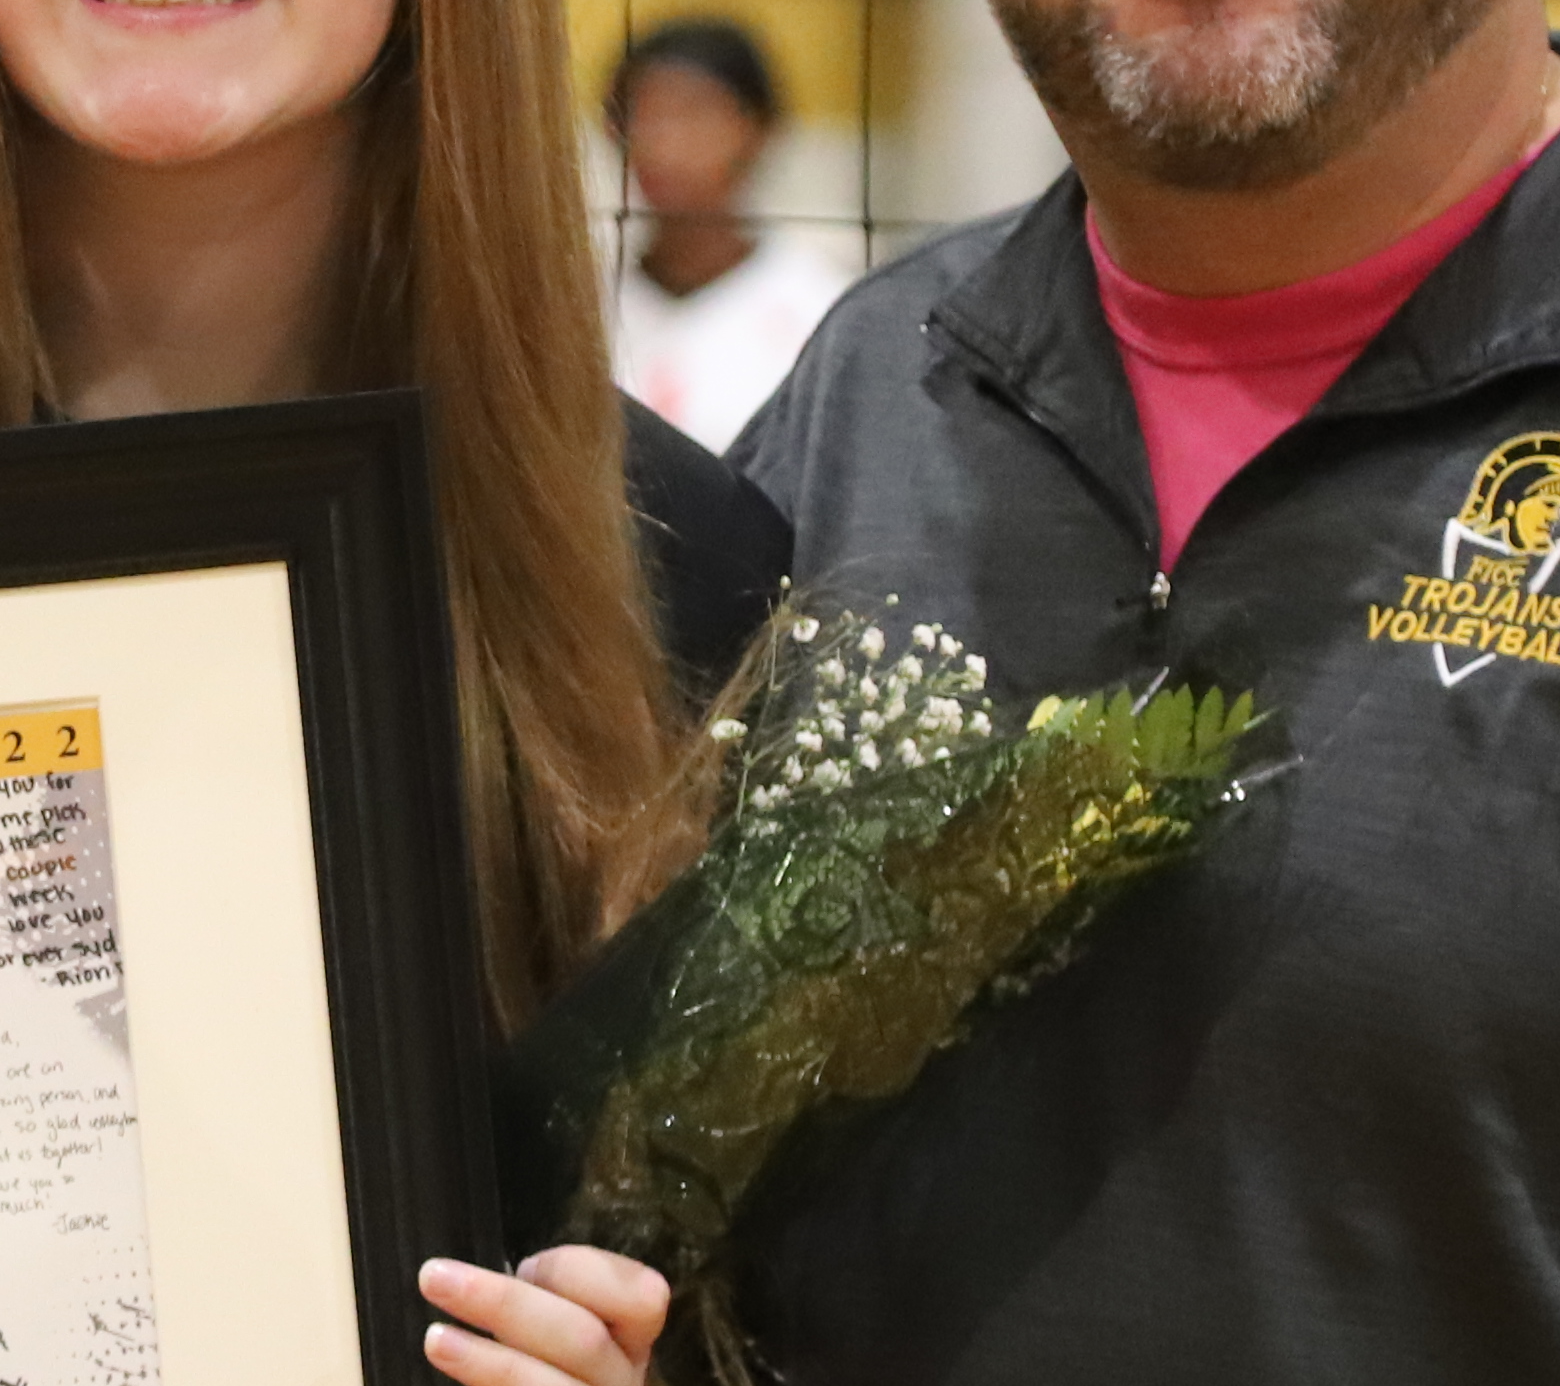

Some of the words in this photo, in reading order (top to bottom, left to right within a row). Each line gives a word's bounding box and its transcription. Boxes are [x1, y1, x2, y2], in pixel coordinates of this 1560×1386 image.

[47, 771, 75, 790] for
[9, 885, 75, 907] week
[9, 914, 51, 932] love
[66, 906, 104, 927] you
[7, 1063, 31, 1079] are
[42, 1062, 64, 1075] an
[93, 1084, 120, 1100] and
[47, 1115, 80, 1142] glad
